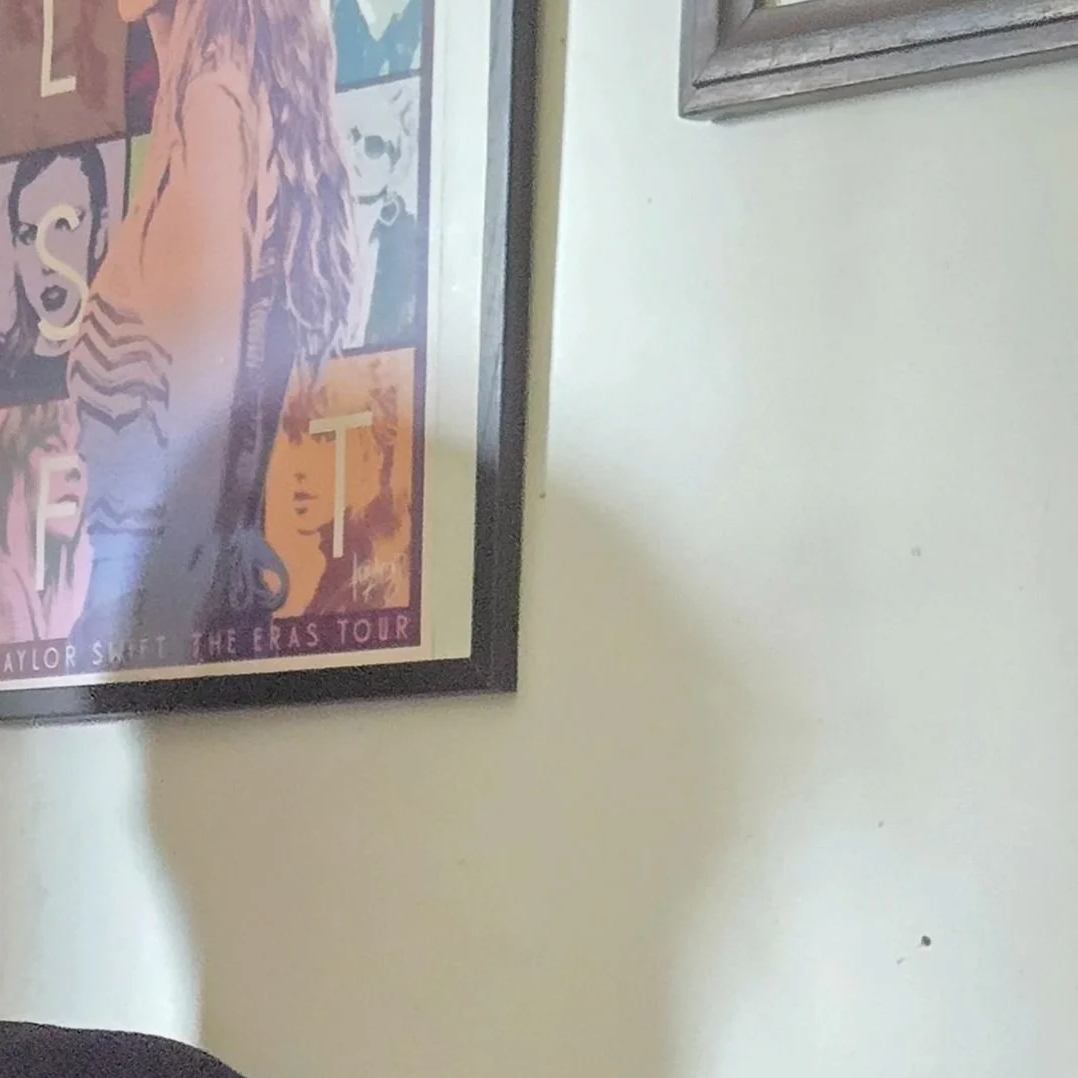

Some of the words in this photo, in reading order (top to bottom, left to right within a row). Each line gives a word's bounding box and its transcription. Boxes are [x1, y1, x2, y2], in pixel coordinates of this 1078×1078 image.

[40, 0, 77, 98] L
[36, 204, 90, 342] S
[35, 454, 79, 592] F
[308, 410, 373, 558] T
[191, 629, 237, 660] THE
[253, 622, 320, 652] ERAS
[337, 615, 410, 645] TOUR
